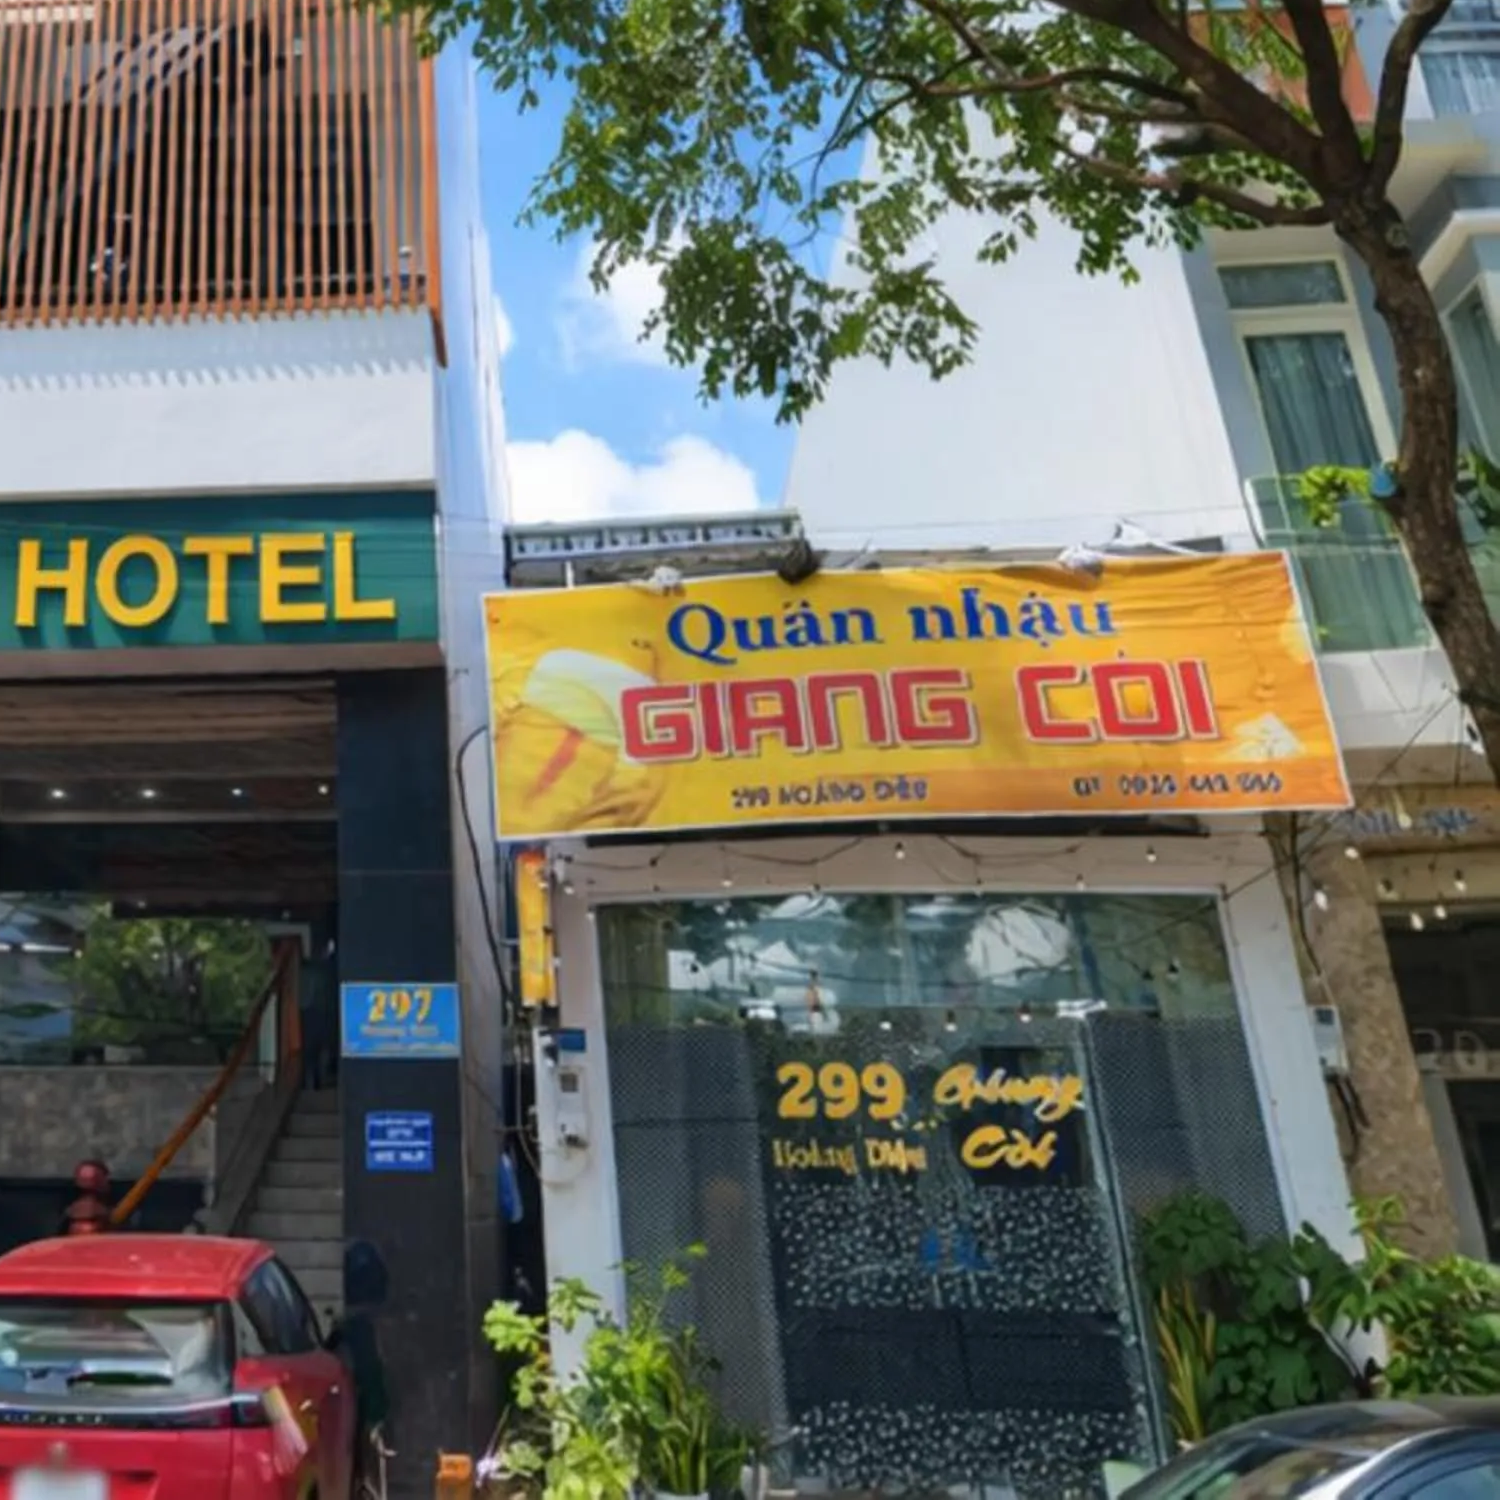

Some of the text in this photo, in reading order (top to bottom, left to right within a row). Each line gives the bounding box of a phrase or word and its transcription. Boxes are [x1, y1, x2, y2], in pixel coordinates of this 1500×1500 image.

[15, 531, 396, 627] HOTEL
[619, 668, 977, 764] GIANG
[776, 1062, 906, 1120] 299
